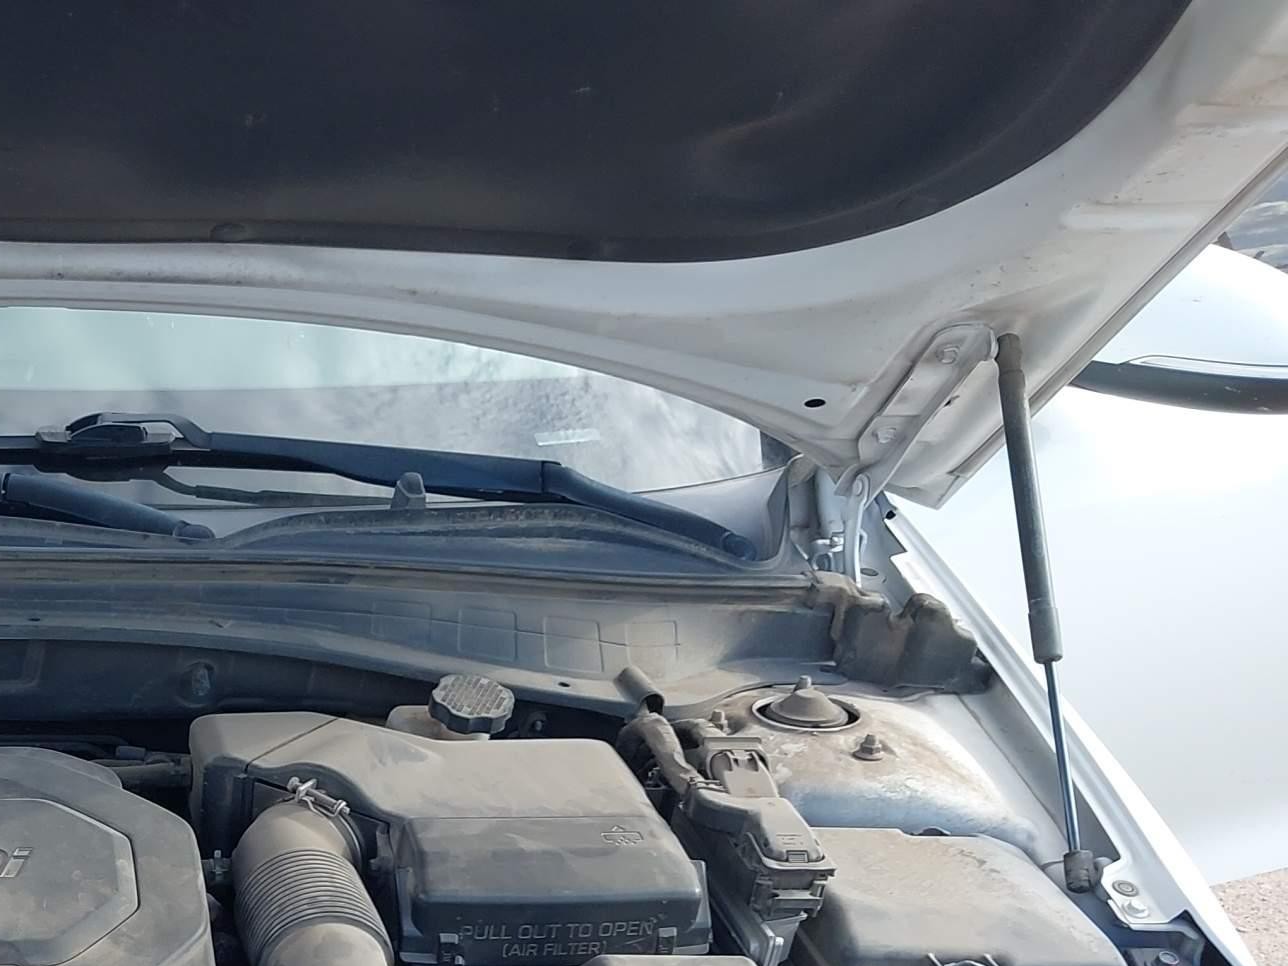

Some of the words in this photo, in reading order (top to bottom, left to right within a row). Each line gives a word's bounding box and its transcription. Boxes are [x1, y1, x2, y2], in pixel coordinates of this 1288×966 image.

[461, 925, 513, 940] PULL
[517, 923, 562, 939] OUT
[566, 922, 592, 938] TO
[598, 920, 655, 937] OPEN
[501, 942, 538, 958] (AIR
[543, 939, 608, 956] FILTER)
